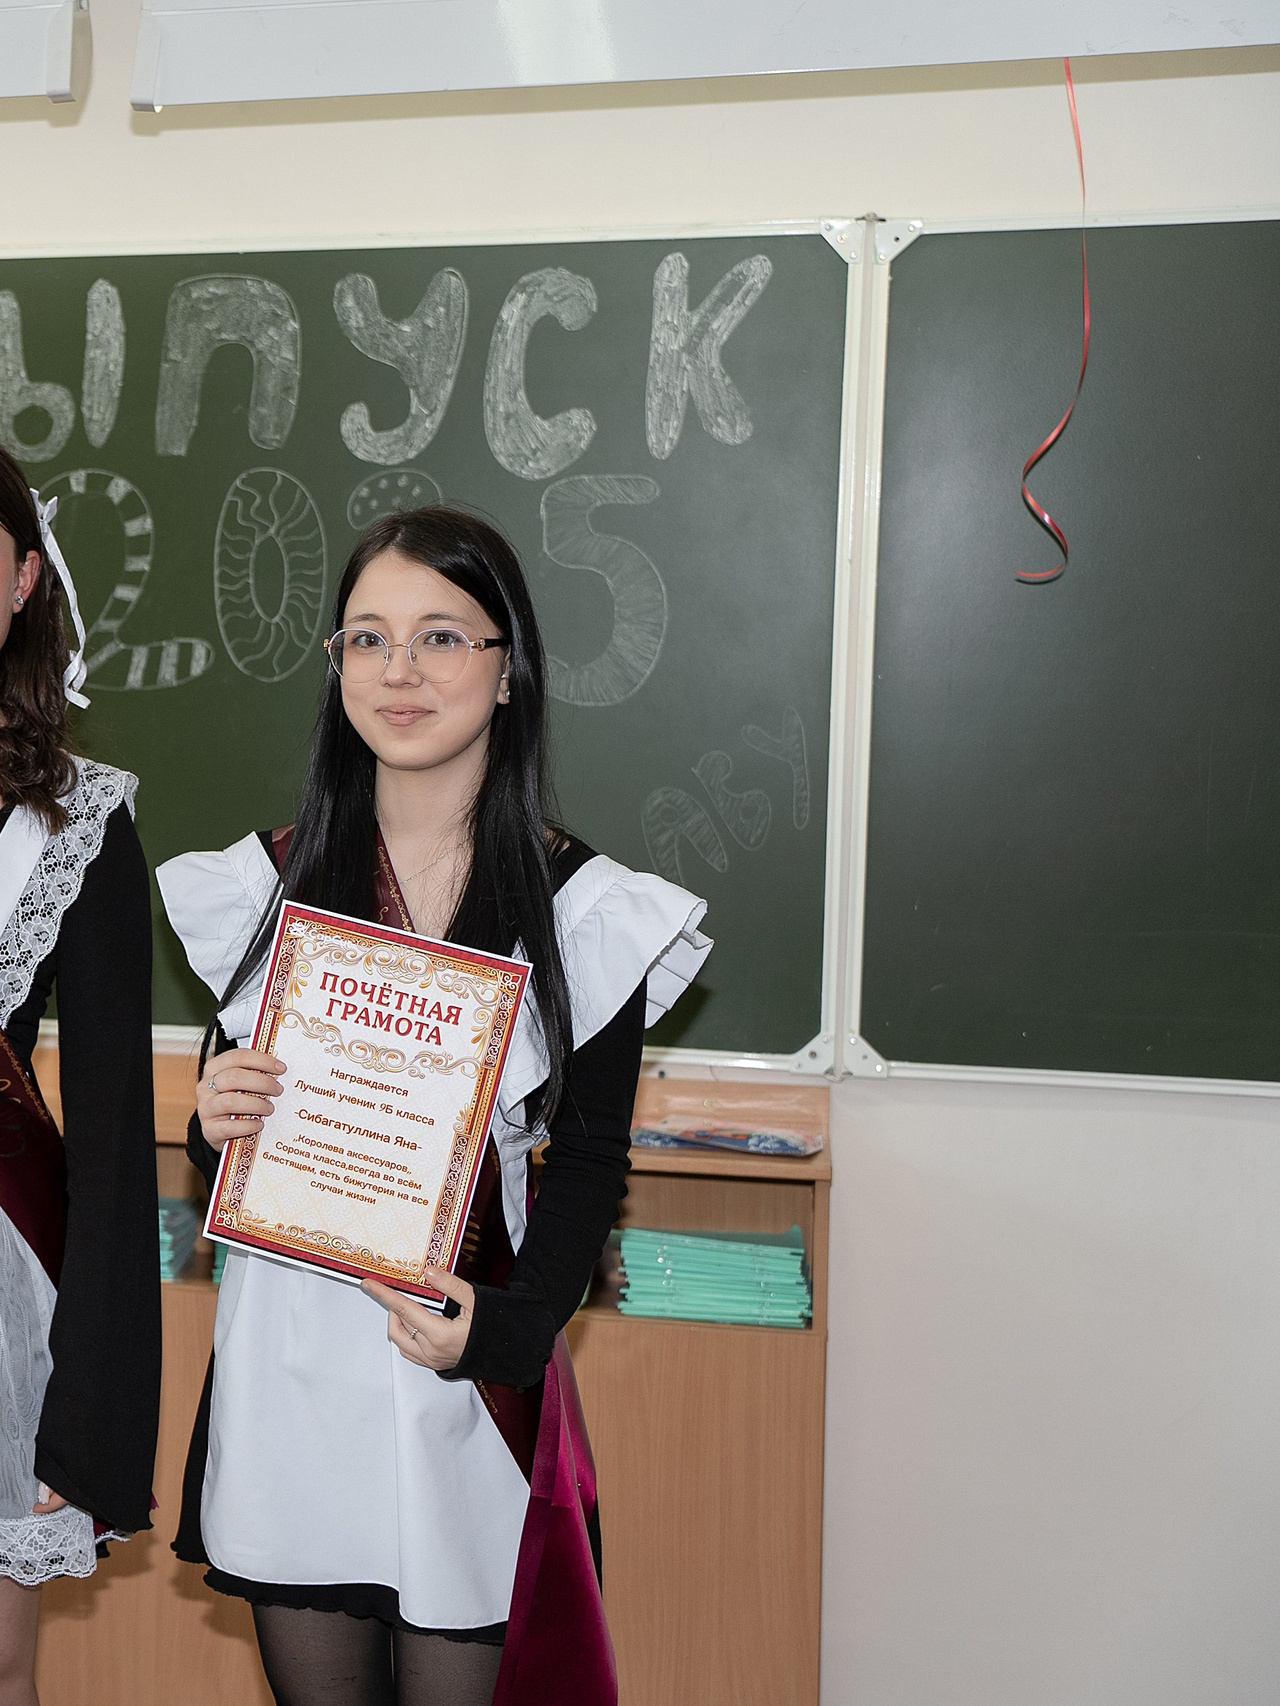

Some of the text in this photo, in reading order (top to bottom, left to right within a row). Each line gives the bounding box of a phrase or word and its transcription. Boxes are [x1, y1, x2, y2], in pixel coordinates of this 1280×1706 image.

[38, 466, 668, 706] 205
[319, 971, 463, 1026] ПОЧЁТНАЯ
[325, 998, 442, 1046] ГРАМОТА
[294, 1079, 435, 1126] Лучший ученик 9Б класса
[330, 1067, 409, 1097] Награждается
[262, 1151, 429, 1206] блестящем, есть бижутерия на все
[275, 1141, 310, 1158] Сорока
[383, 1173, 395, 1183] во
[397, 1177, 422, 1191] всём
[345, 1190, 376, 1205] жизни
